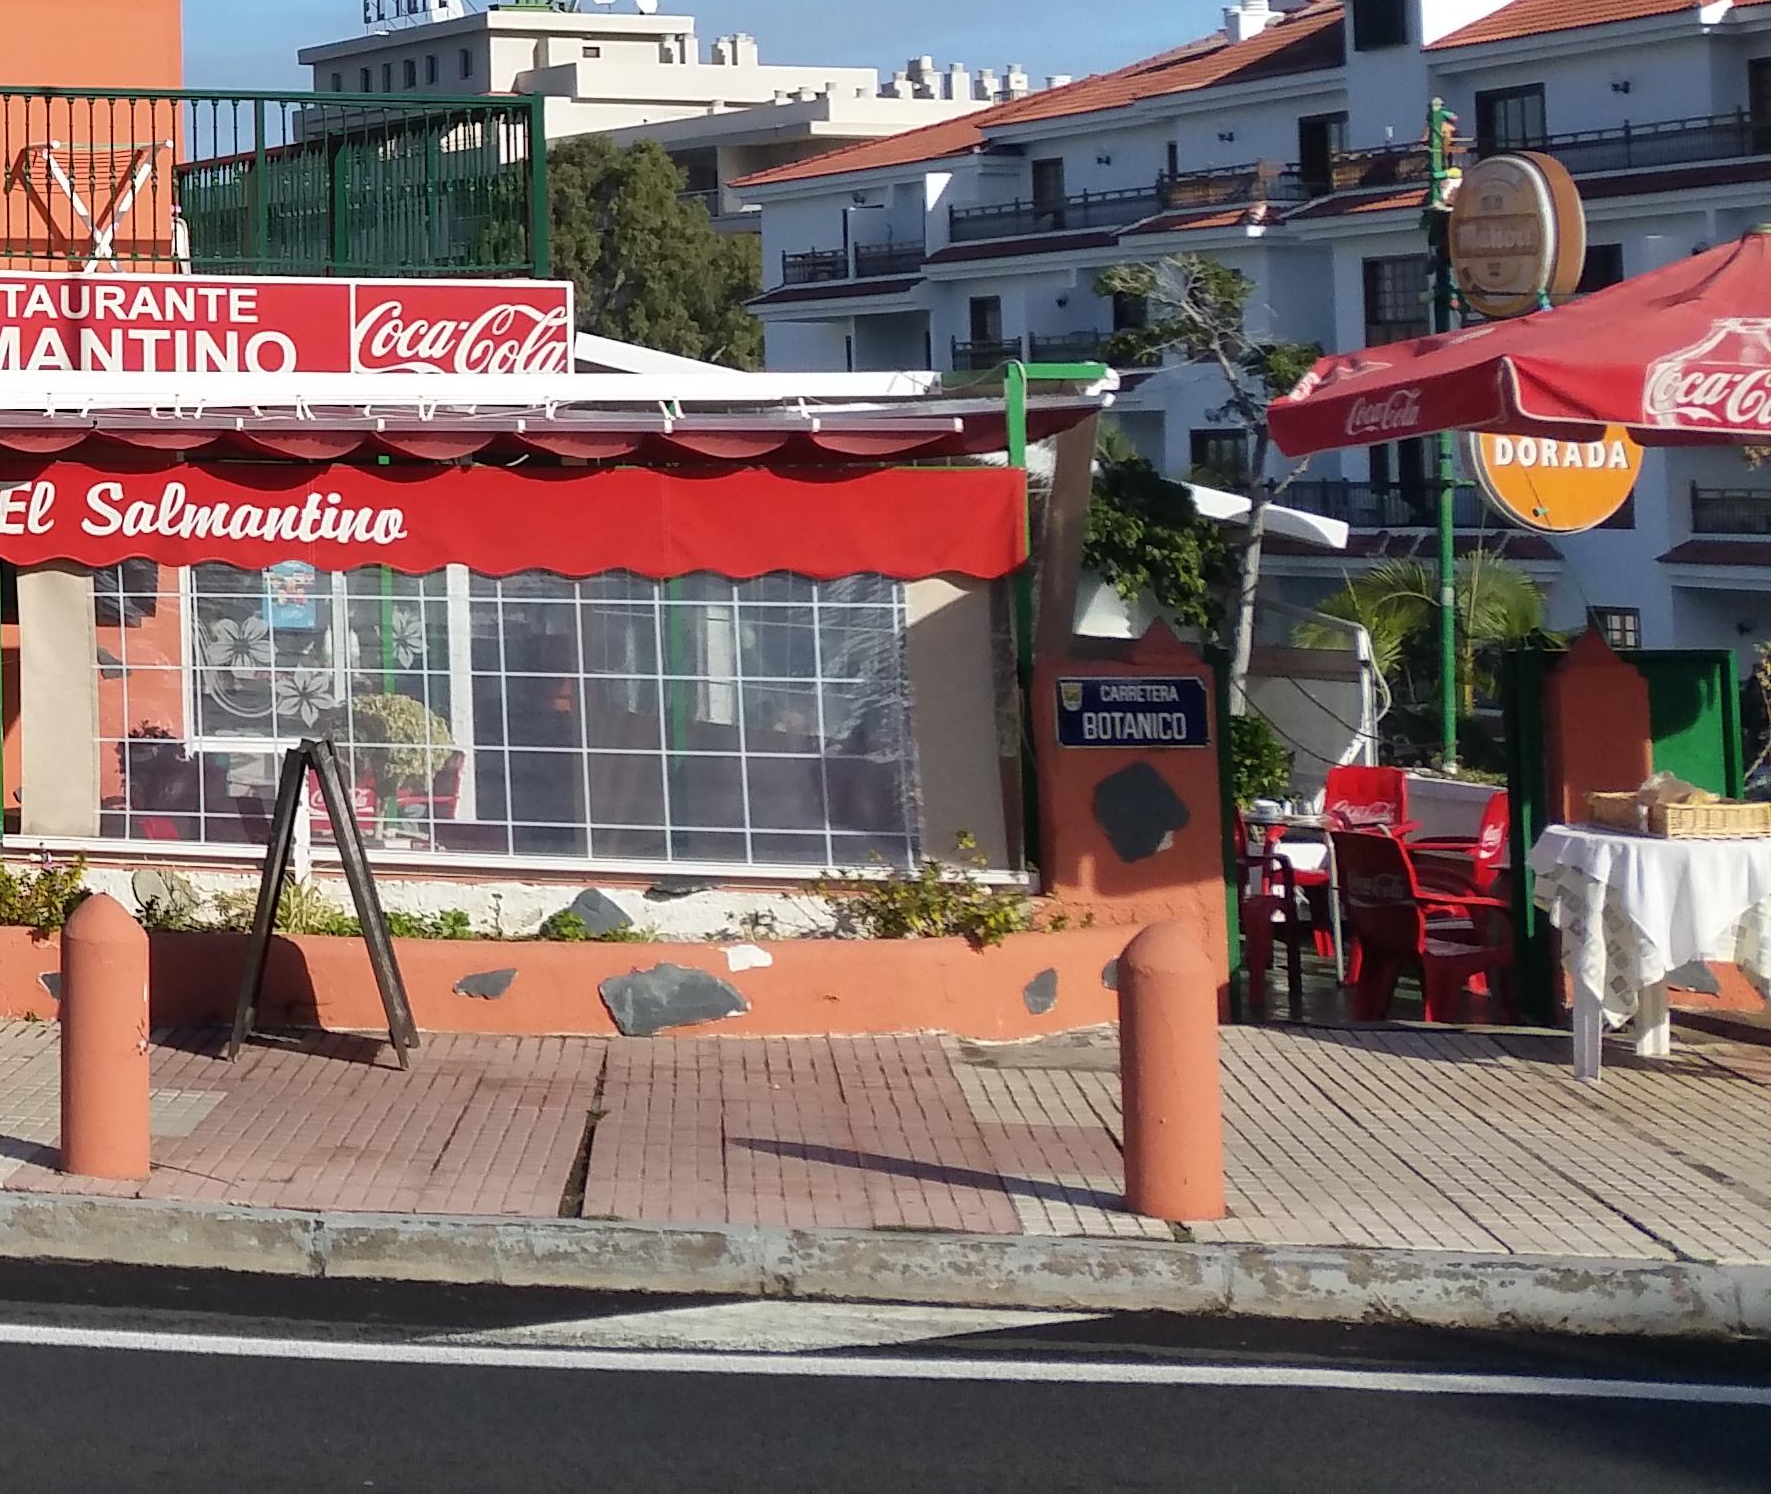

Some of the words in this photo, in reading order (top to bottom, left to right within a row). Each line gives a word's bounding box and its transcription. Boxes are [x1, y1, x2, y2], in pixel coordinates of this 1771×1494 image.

[355, 300, 568, 374] Coca-Cola
[1494, 436, 1630, 470] DORADA
[81, 481, 409, 545] Salmantino
[1099, 685, 1180, 703] CARRETERA
[1082, 712, 1187, 741] BOTANICO
